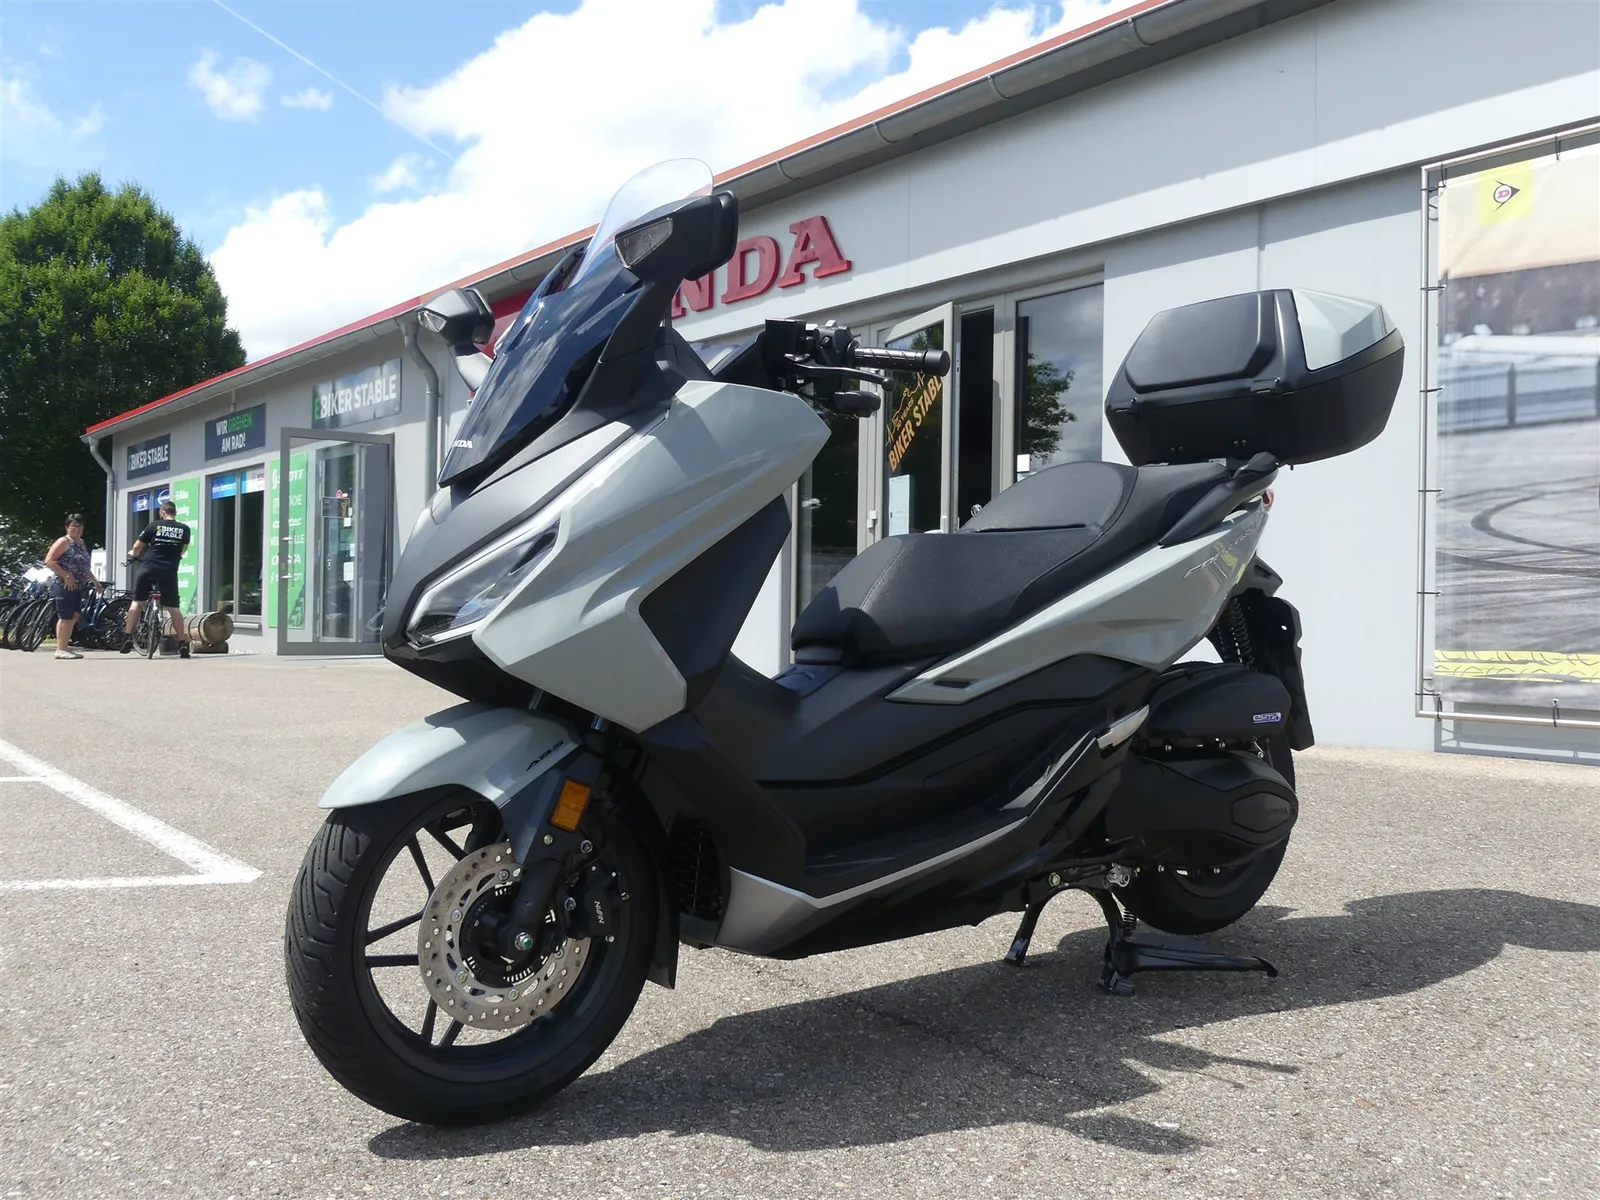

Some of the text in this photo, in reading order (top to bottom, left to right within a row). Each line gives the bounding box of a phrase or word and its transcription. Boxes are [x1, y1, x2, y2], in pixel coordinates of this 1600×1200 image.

[671, 215, 852, 319] NDA
[314, 374, 397, 421] EBIKER STABLE
[216, 419, 228, 437] WIR
[888, 375, 943, 472] BIKER STABL
[221, 432, 246, 453] AM RAD!
[453, 439, 473, 449] NDA
[147, 444, 169, 466] STABLE
[155, 530, 183, 540] STABLE
